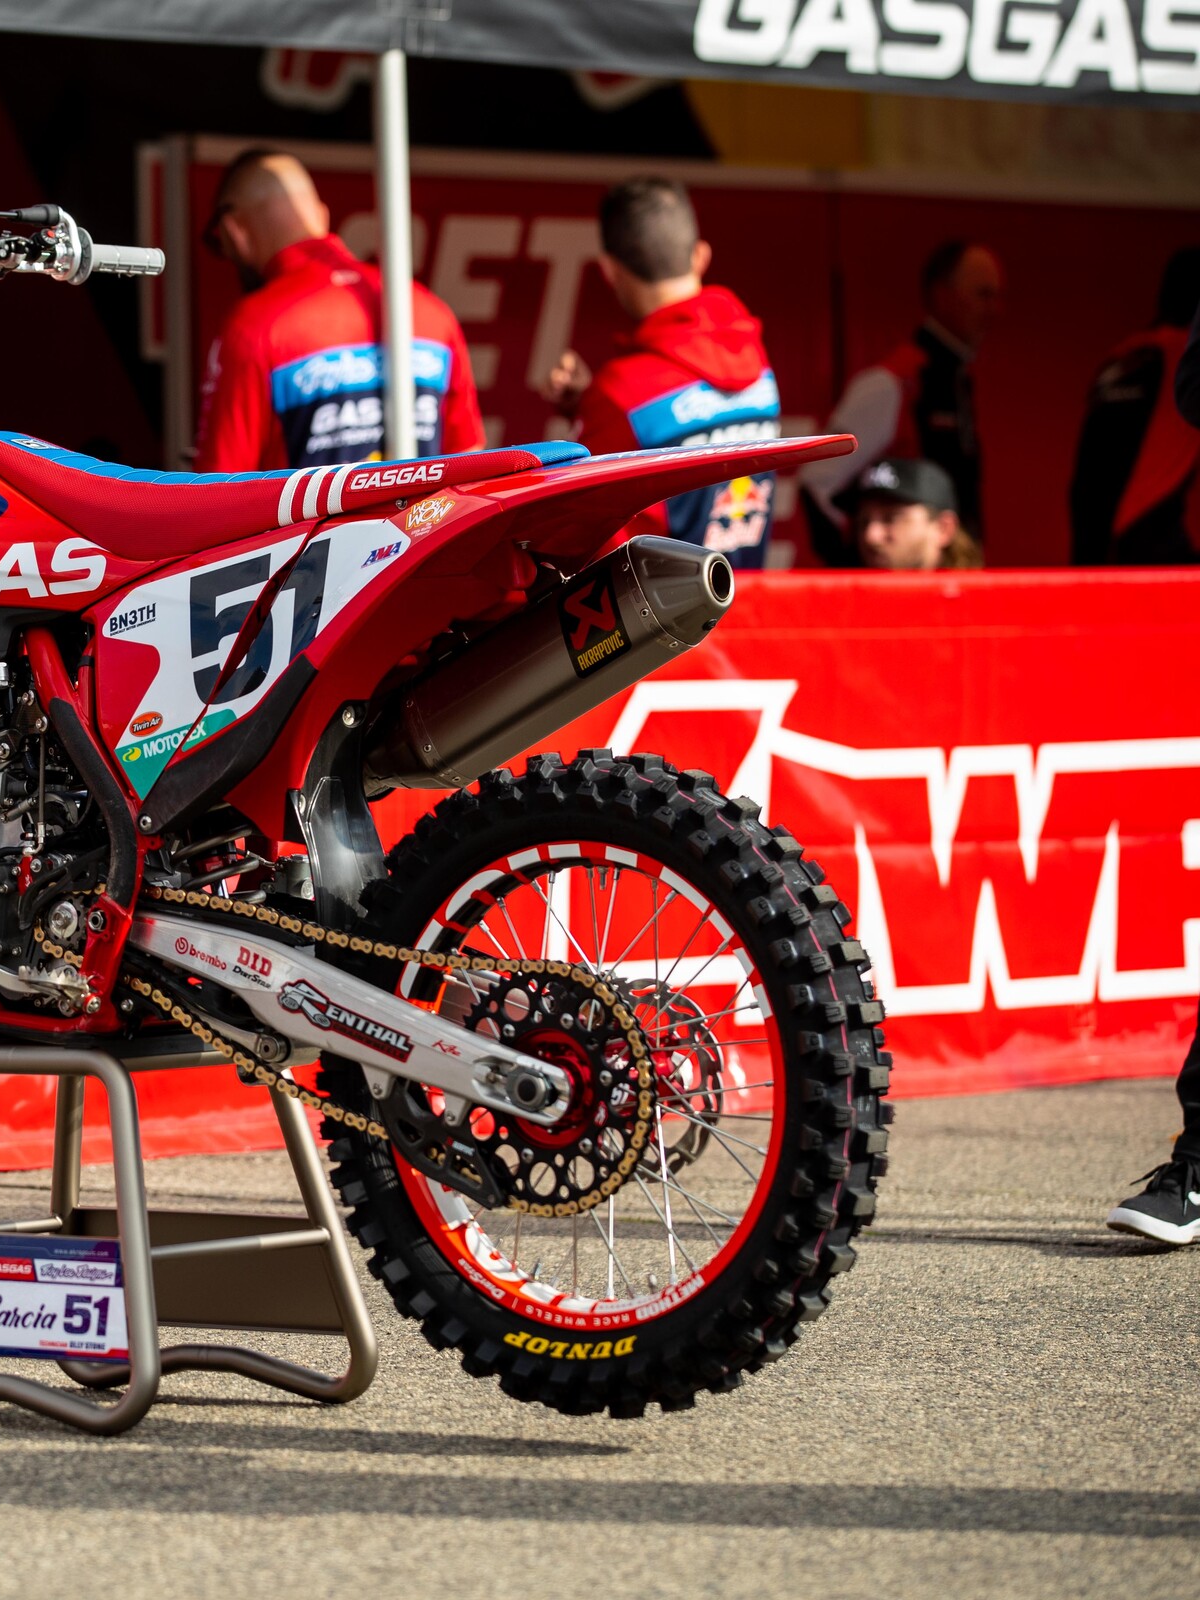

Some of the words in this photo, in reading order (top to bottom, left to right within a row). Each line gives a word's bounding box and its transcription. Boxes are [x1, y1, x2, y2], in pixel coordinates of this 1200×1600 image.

[350, 463, 445, 490] GASGAS
[361, 541, 402, 568] AMA
[110, 603, 156, 632] BN3TH
[190, 538, 331, 704] 51
[133, 721, 150, 733] Twin
[150, 716, 162, 727] Air
[189, 943, 228, 971] brembo
[635, 1273, 706, 1321] METHOD
[63, 1293, 111, 1337] 51
[525, 1304, 587, 1327] WHEELS
[593, 1312, 630, 1327] RACE
[503, 1331, 638, 1361] DUNLOP
